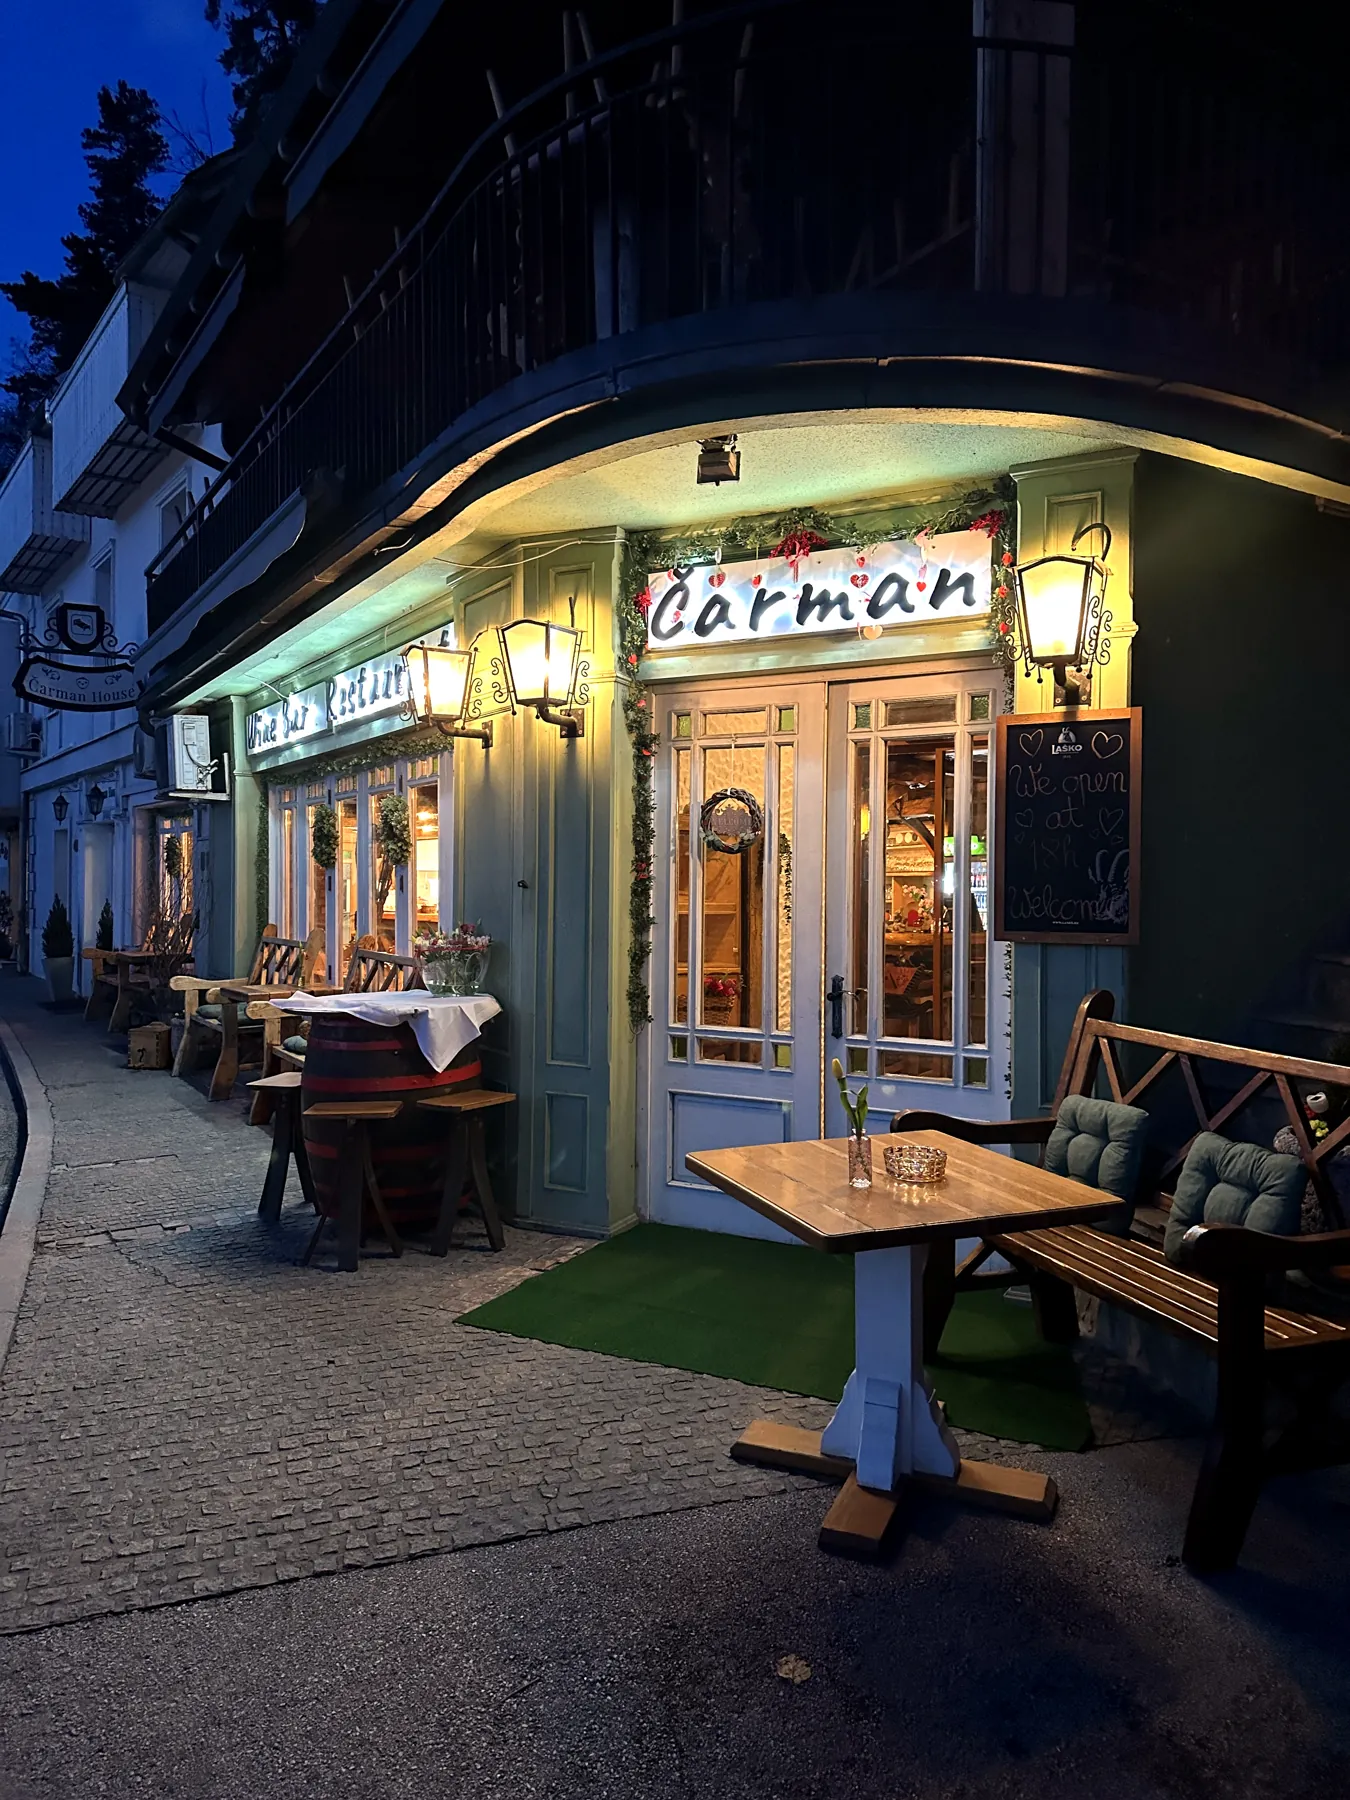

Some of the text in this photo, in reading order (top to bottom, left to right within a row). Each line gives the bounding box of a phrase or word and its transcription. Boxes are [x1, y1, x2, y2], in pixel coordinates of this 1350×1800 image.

[651, 566, 977, 640] Čarman
[28, 675, 136, 702] Čarman House
[248, 712, 277, 750] Wine
[282, 698, 309, 739] Bar
[1051, 743, 1083, 755] LAŠKO
[1009, 763, 1127, 806] We open
[1046, 796, 1083, 830] at
